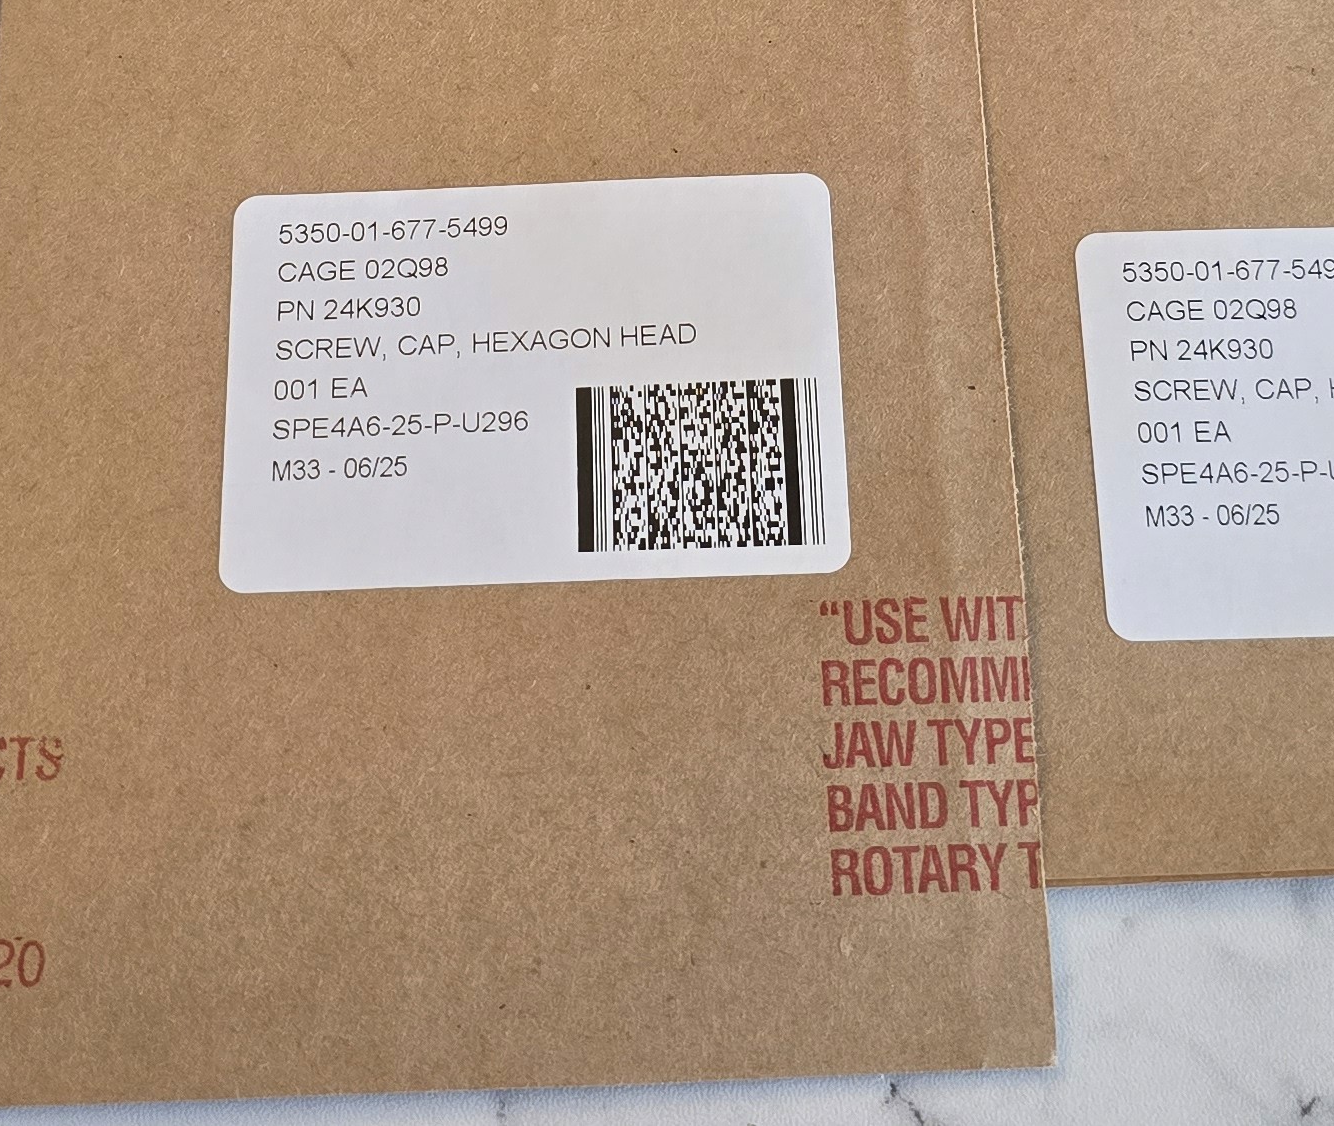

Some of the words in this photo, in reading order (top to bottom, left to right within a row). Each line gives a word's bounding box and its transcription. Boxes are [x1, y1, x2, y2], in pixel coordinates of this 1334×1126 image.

[278, 215, 508, 245] 5350-01-677-5499
[277, 259, 356, 283] CAGE
[365, 256, 449, 280] 02Q98
[277, 299, 315, 322] PN
[323, 295, 421, 321] 24K930
[1126, 299, 1205, 322] CAGE
[1213, 298, 1298, 321] 02Q98
[275, 335, 387, 362] SCREW,
[397, 333, 461, 359] CAP,
[472, 326, 611, 354] HEXAGON
[620, 322, 697, 348] HEAD
[1130, 339, 1169, 362] PN
[1176, 338, 1274, 362] 24K930
[273, 378, 317, 401] 001
[331, 376, 369, 399] EA
[1133, 378, 1245, 405] SCREW,
[1255, 377, 1319, 404] CAP,
[272, 410, 529, 441] SPE4A6-25-P-U296
[1137, 421, 1181, 444] 001
[1193, 420, 1232, 443] EA
[271, 458, 321, 482] M33
[343, 455, 408, 479] 06/25
[1145, 504, 1195, 528] M33
[1216, 503, 1280, 526] 06/25
[823, 720, 916, 769] JAW
[827, 783, 947, 832] BAND
[831, 844, 1005, 896] ROTARY
